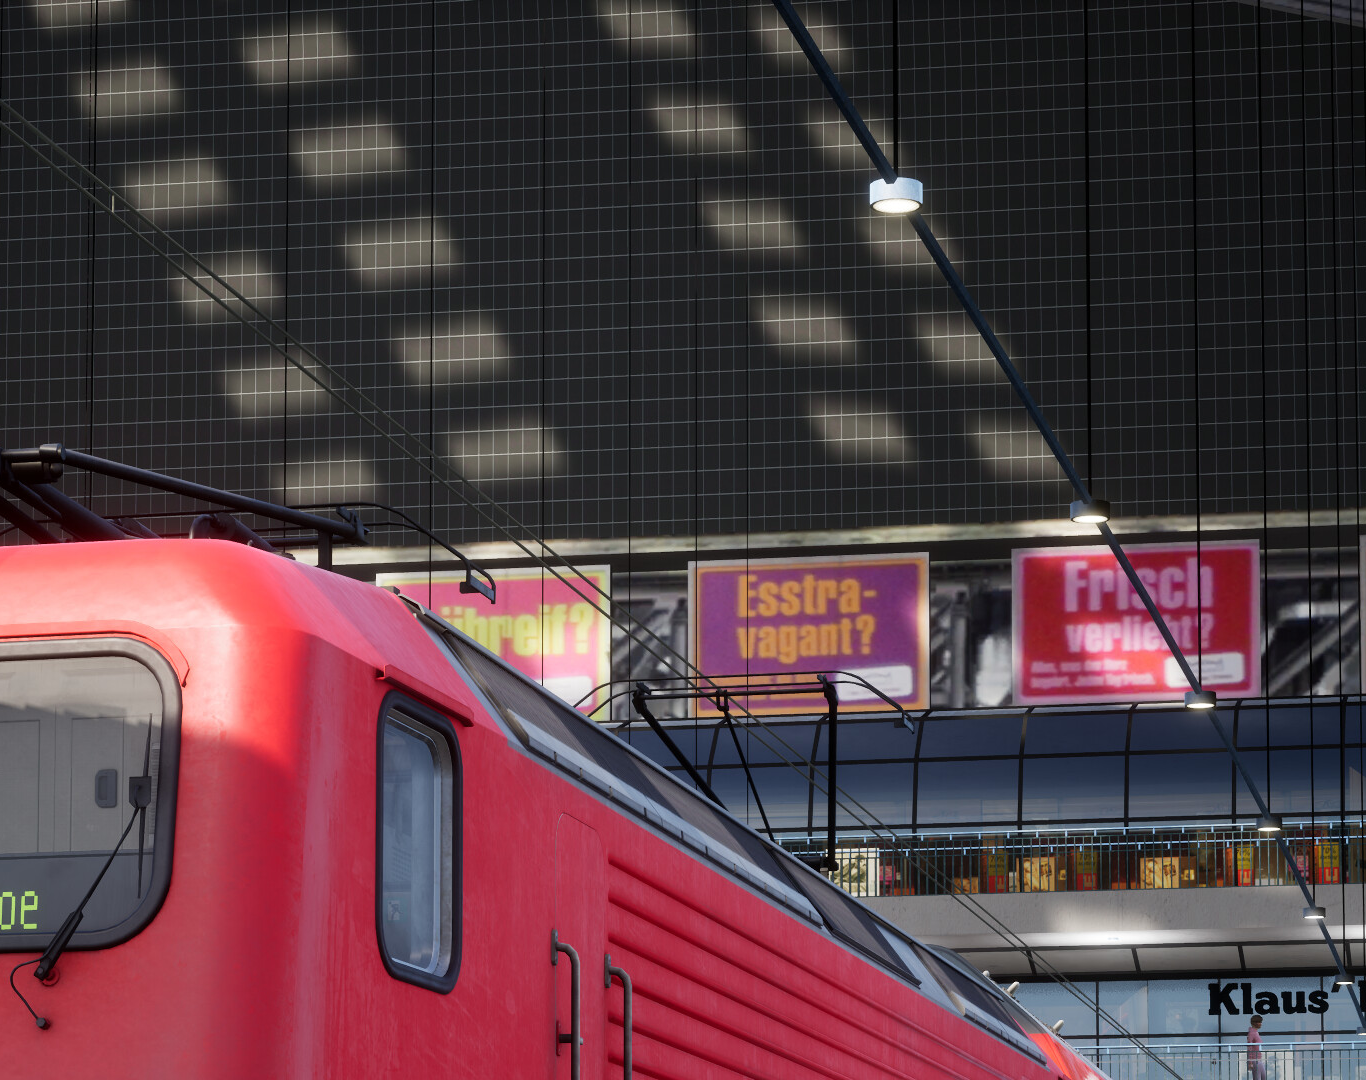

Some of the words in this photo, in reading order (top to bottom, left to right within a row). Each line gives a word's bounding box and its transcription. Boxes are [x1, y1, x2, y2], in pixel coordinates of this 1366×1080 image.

[738, 574, 878, 619] Esstra-
[1064, 556, 1214, 613] Frisch
[737, 614, 876, 664] vagant?
